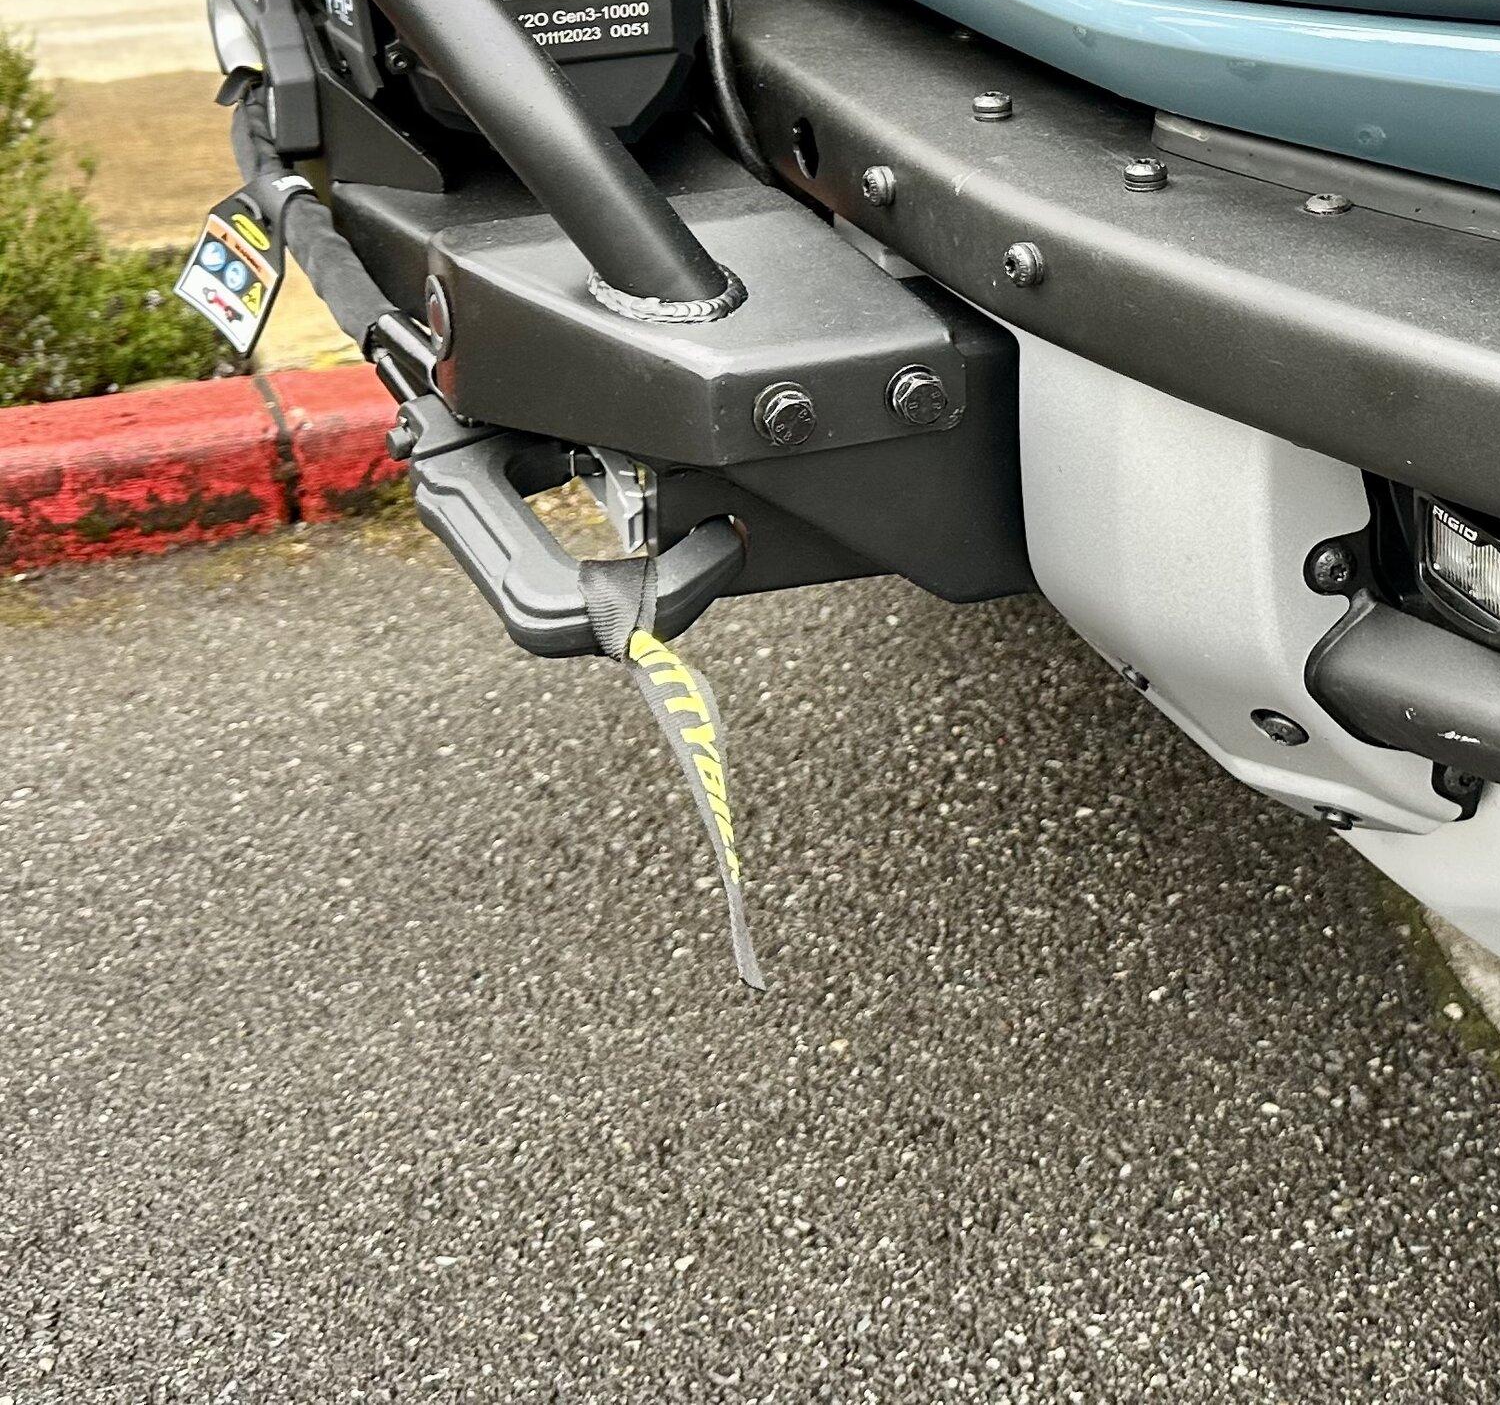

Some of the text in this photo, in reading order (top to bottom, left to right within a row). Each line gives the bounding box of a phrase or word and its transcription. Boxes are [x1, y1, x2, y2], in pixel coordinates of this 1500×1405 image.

[552, 2, 650, 25] Gen3-10000
[532, 22, 649, 46] 01112023 0051
[1432, 504, 1478, 542] RIGID
